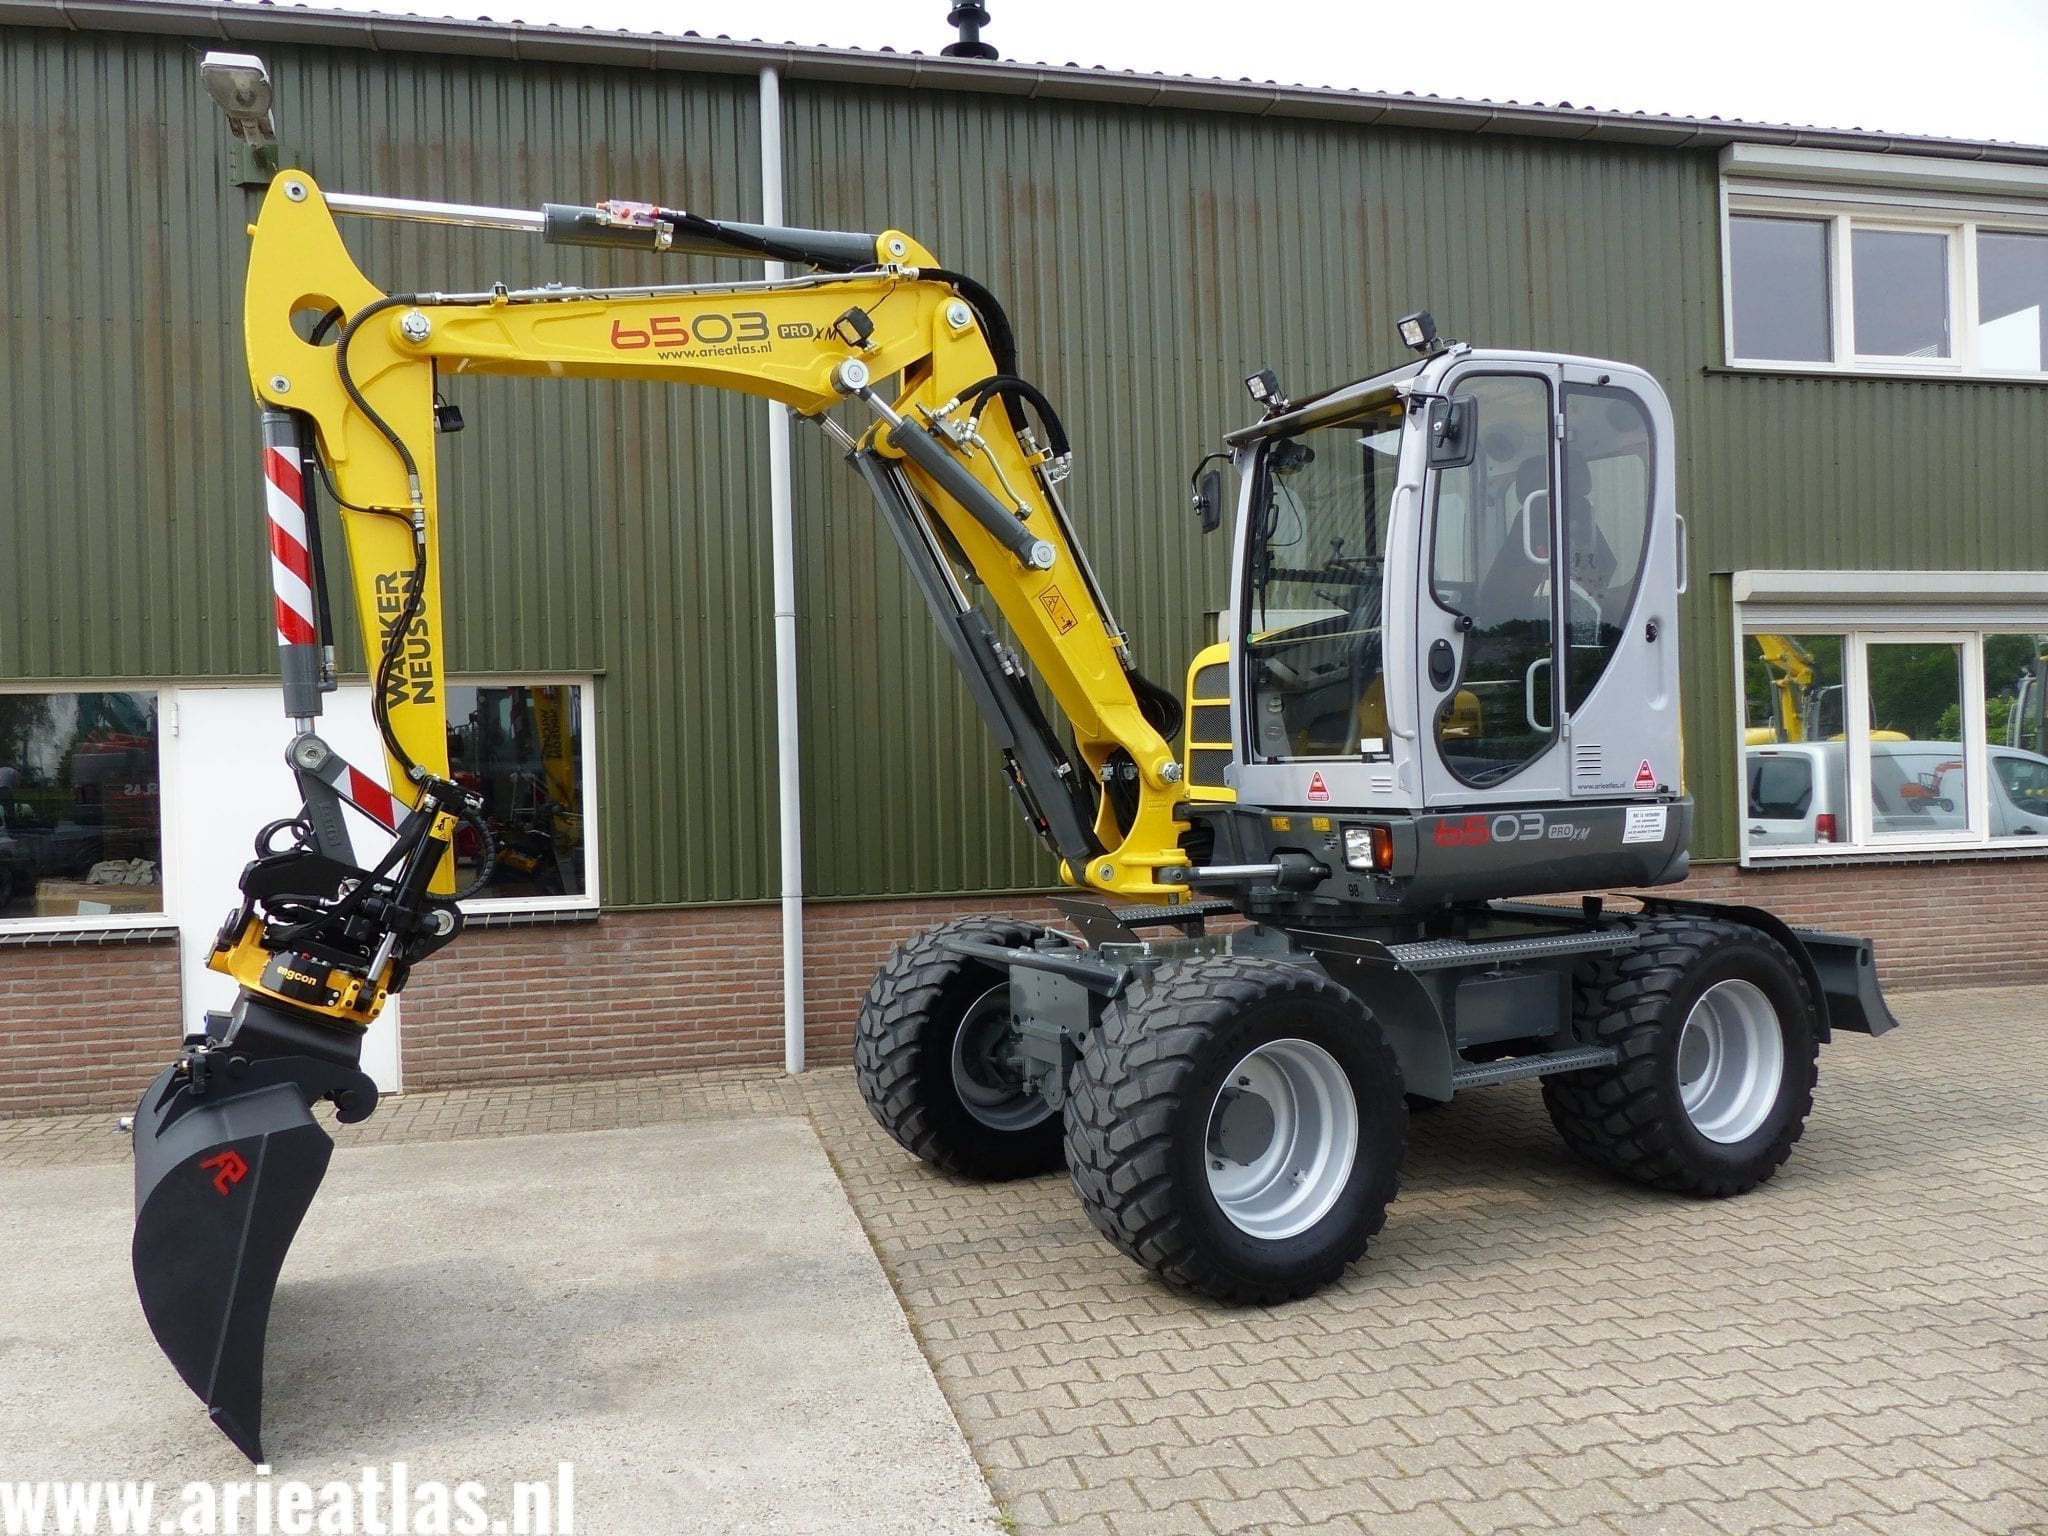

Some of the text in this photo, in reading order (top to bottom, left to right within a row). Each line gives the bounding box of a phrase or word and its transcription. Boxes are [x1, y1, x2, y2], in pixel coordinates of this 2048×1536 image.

[610, 311, 769, 349] 6503
[780, 325, 810, 337] PRO
[657, 341, 772, 360] www.arieatlas.nl
[1434, 813, 1545, 848] 6503
[1551, 826, 1571, 837] PRO
[1348, 884, 1360, 897] 98
[276, 964, 317, 986] engcon
